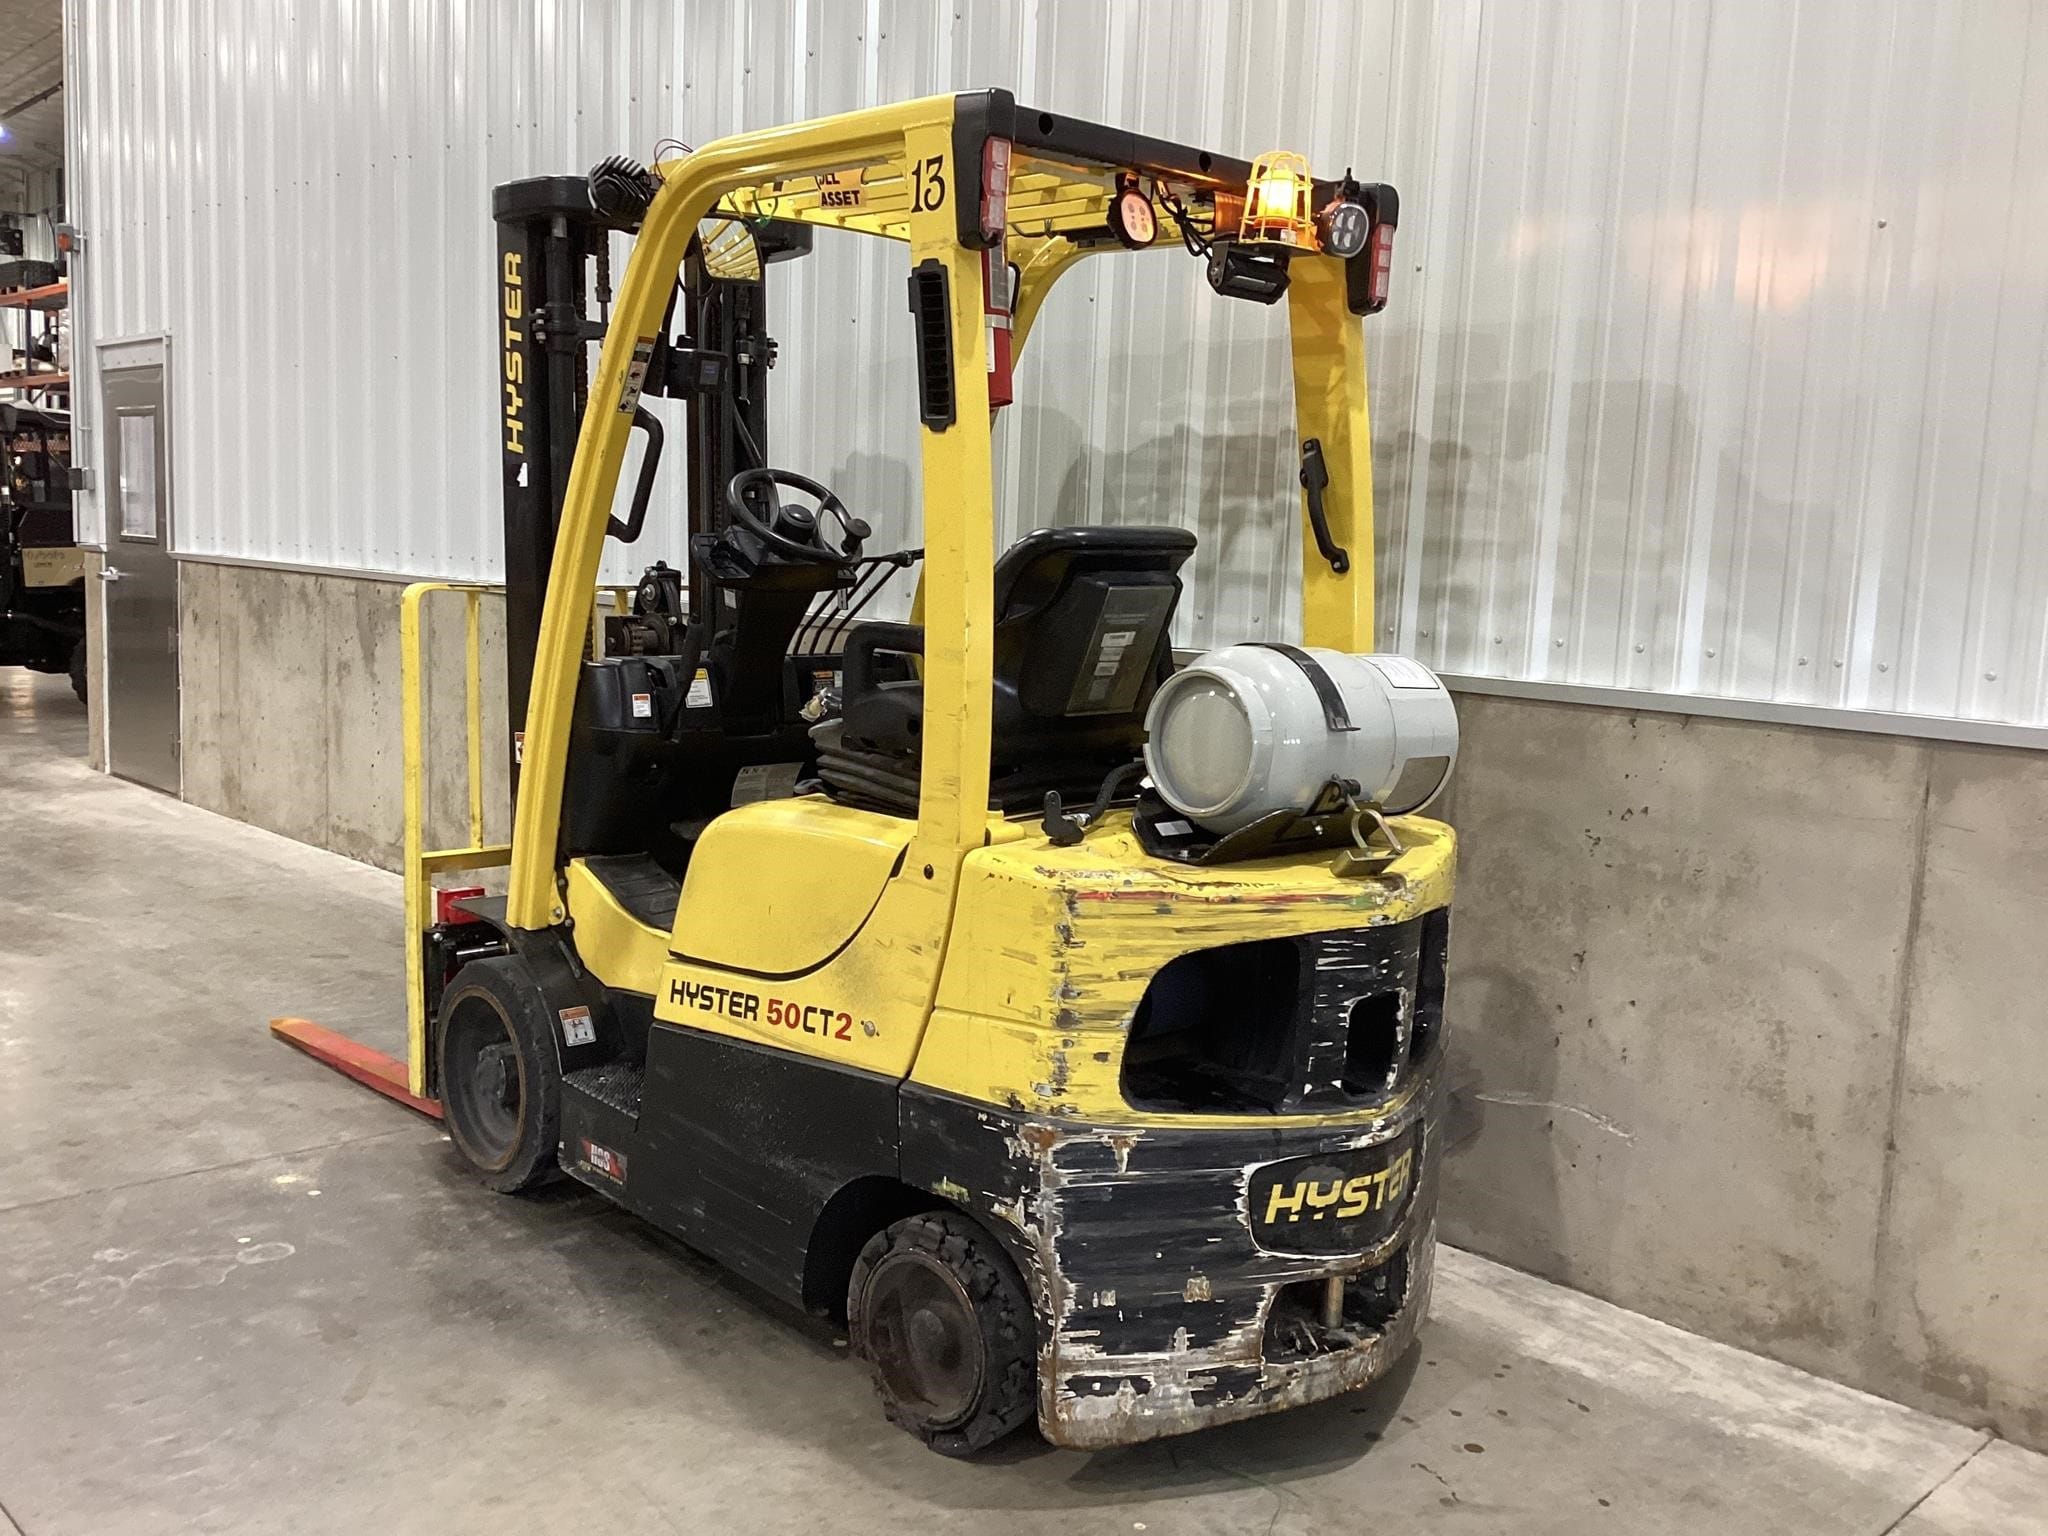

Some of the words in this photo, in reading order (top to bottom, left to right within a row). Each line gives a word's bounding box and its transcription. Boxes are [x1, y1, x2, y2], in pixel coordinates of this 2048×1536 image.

[821, 190, 860, 207] ASSET
[911, 154, 946, 213] 13
[504, 251, 525, 455] HYSTER
[670, 979, 760, 1022] HYSTER
[766, 998, 853, 1042] 50CT2
[1264, 1147, 1413, 1224] HYSTER
